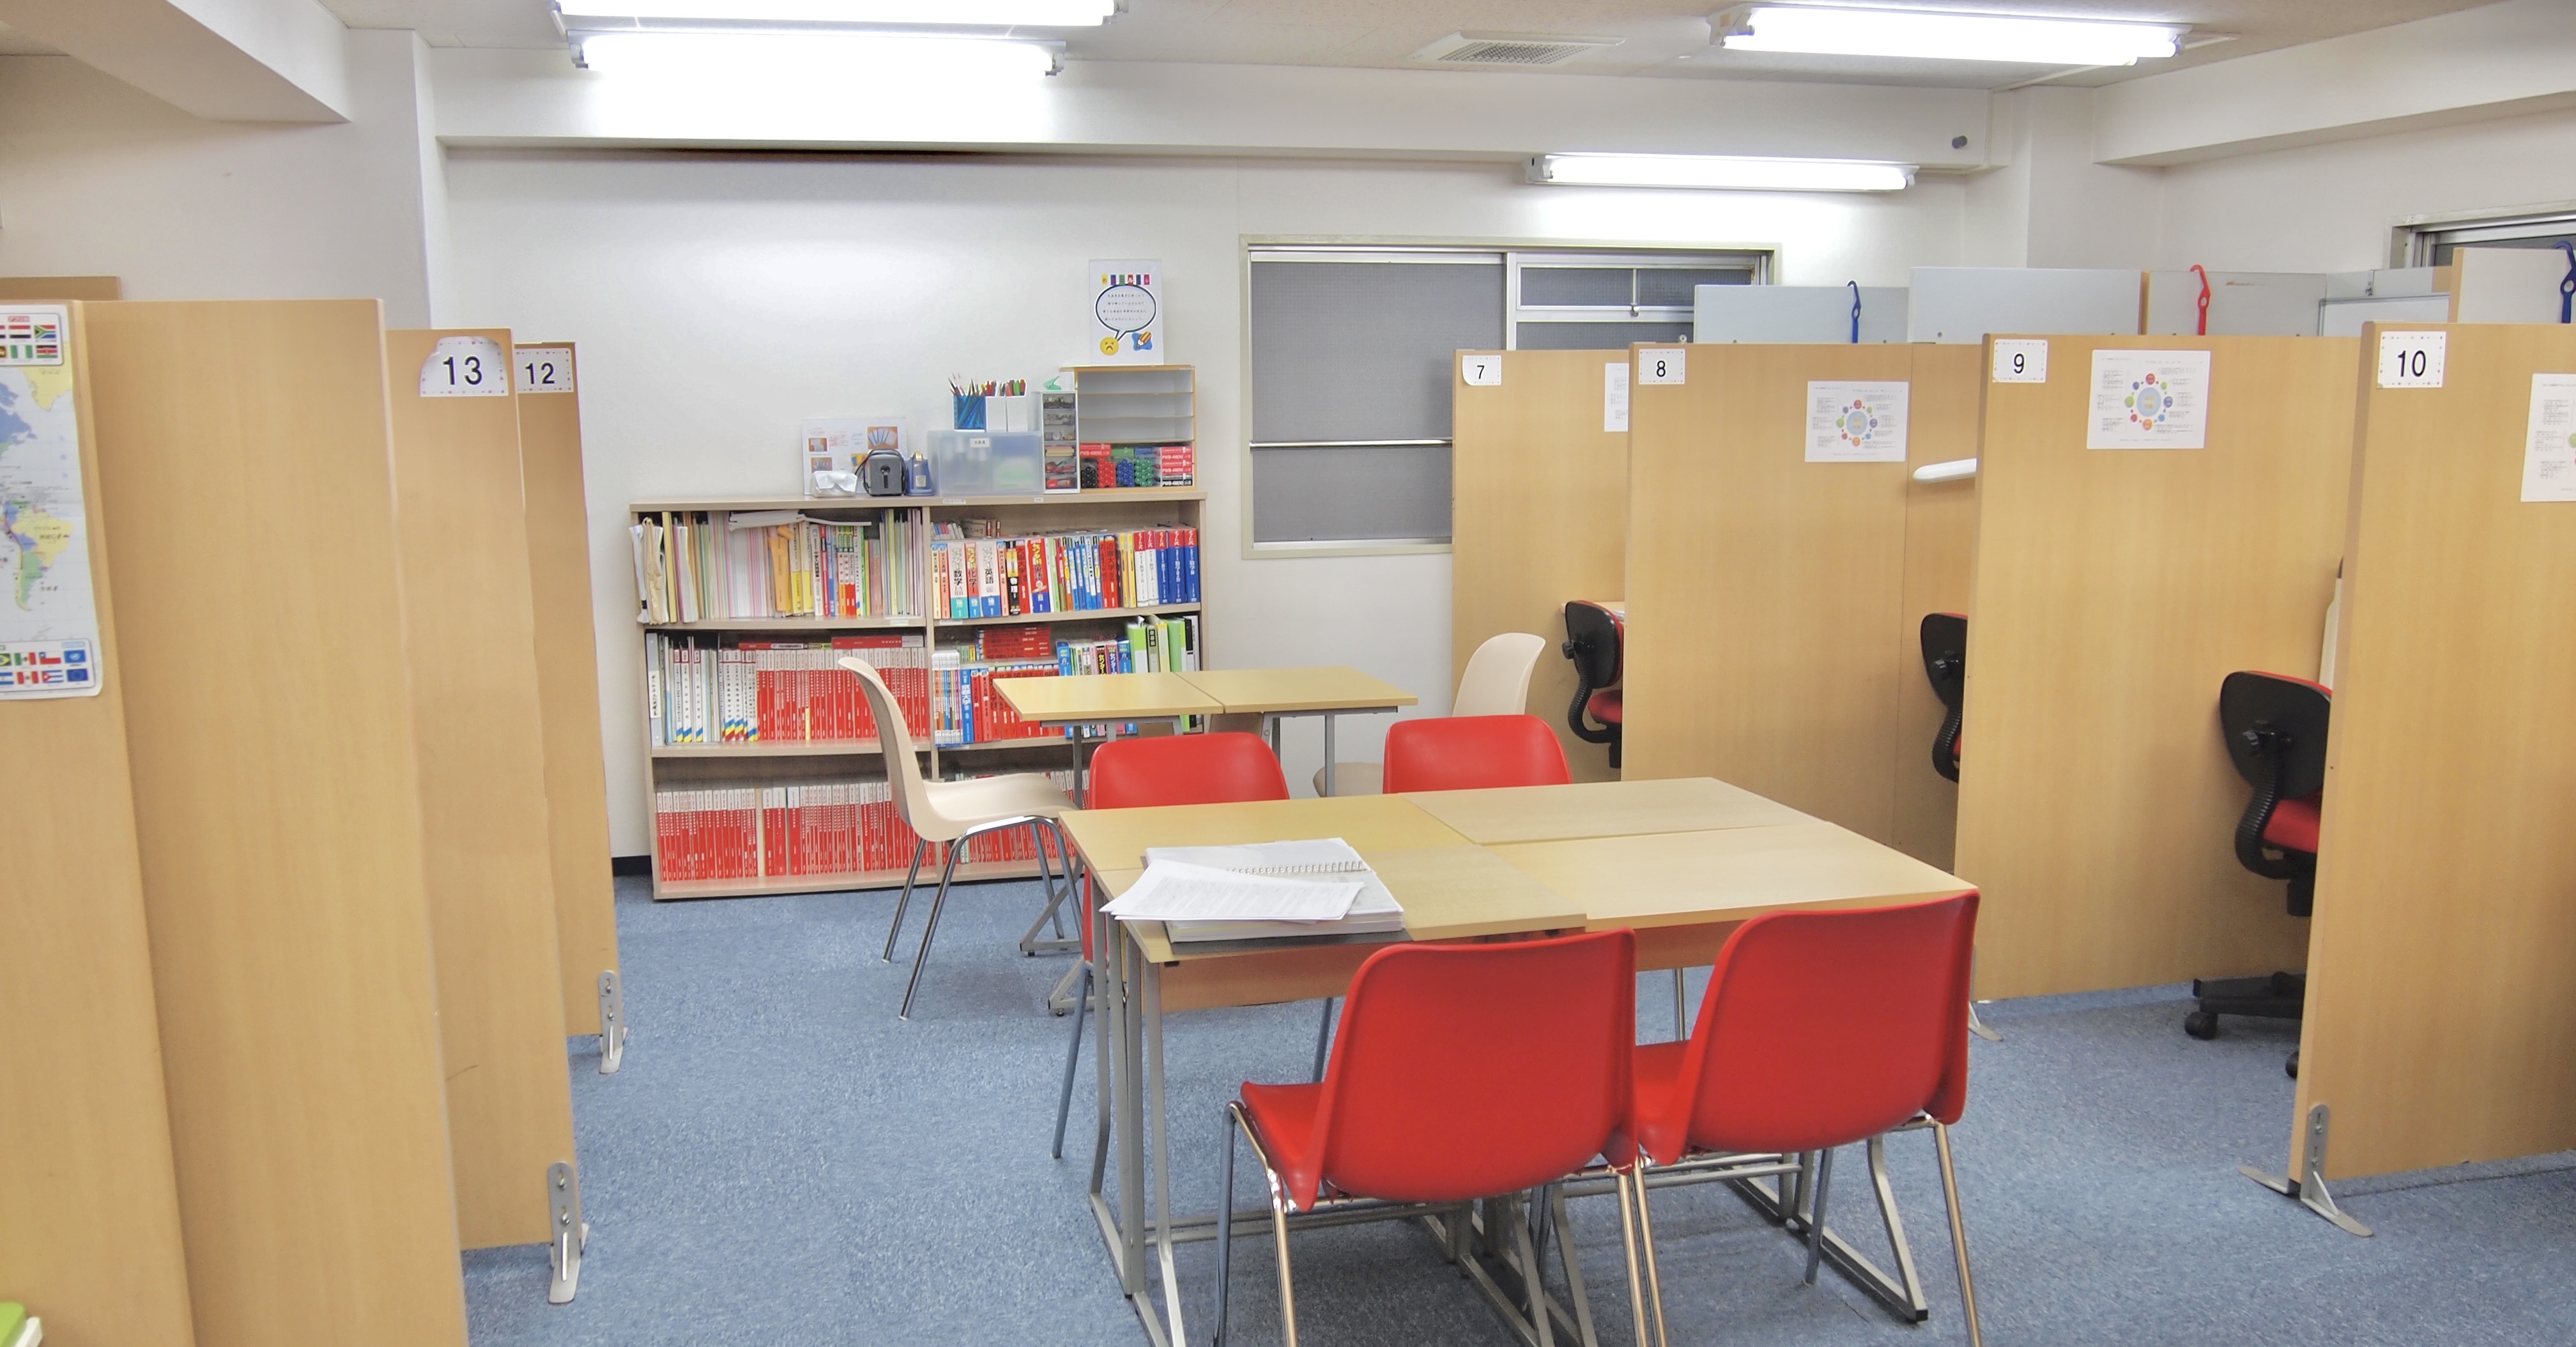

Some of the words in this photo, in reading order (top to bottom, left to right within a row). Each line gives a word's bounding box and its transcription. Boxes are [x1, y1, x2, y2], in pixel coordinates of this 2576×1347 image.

[443, 356, 482, 385] 13
[525, 362, 555, 385] 12
[1476, 364, 1485, 380] 7
[1656, 360, 1666, 378] 8
[2013, 353, 2025, 374] 9
[2398, 350, 2426, 377] 10
